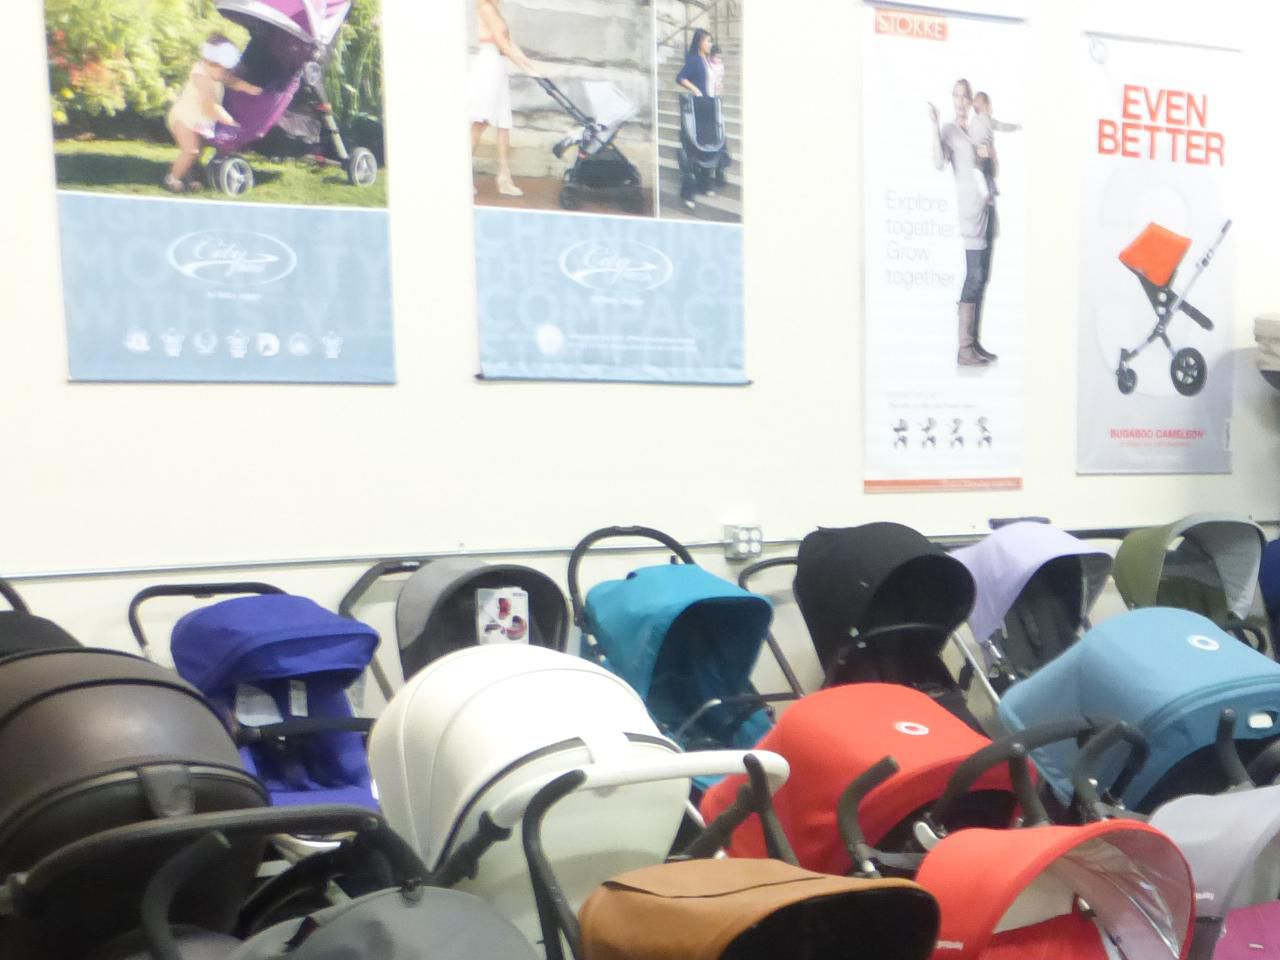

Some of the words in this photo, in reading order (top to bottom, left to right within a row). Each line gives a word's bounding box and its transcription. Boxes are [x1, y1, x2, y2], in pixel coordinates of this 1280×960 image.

[879, 12, 945, 39] STOKKE
[1122, 84, 1207, 128] EVEN
[1098, 118, 1225, 167] BETTER
[885, 189, 948, 213] Explore
[886, 240, 930, 261] Grow
